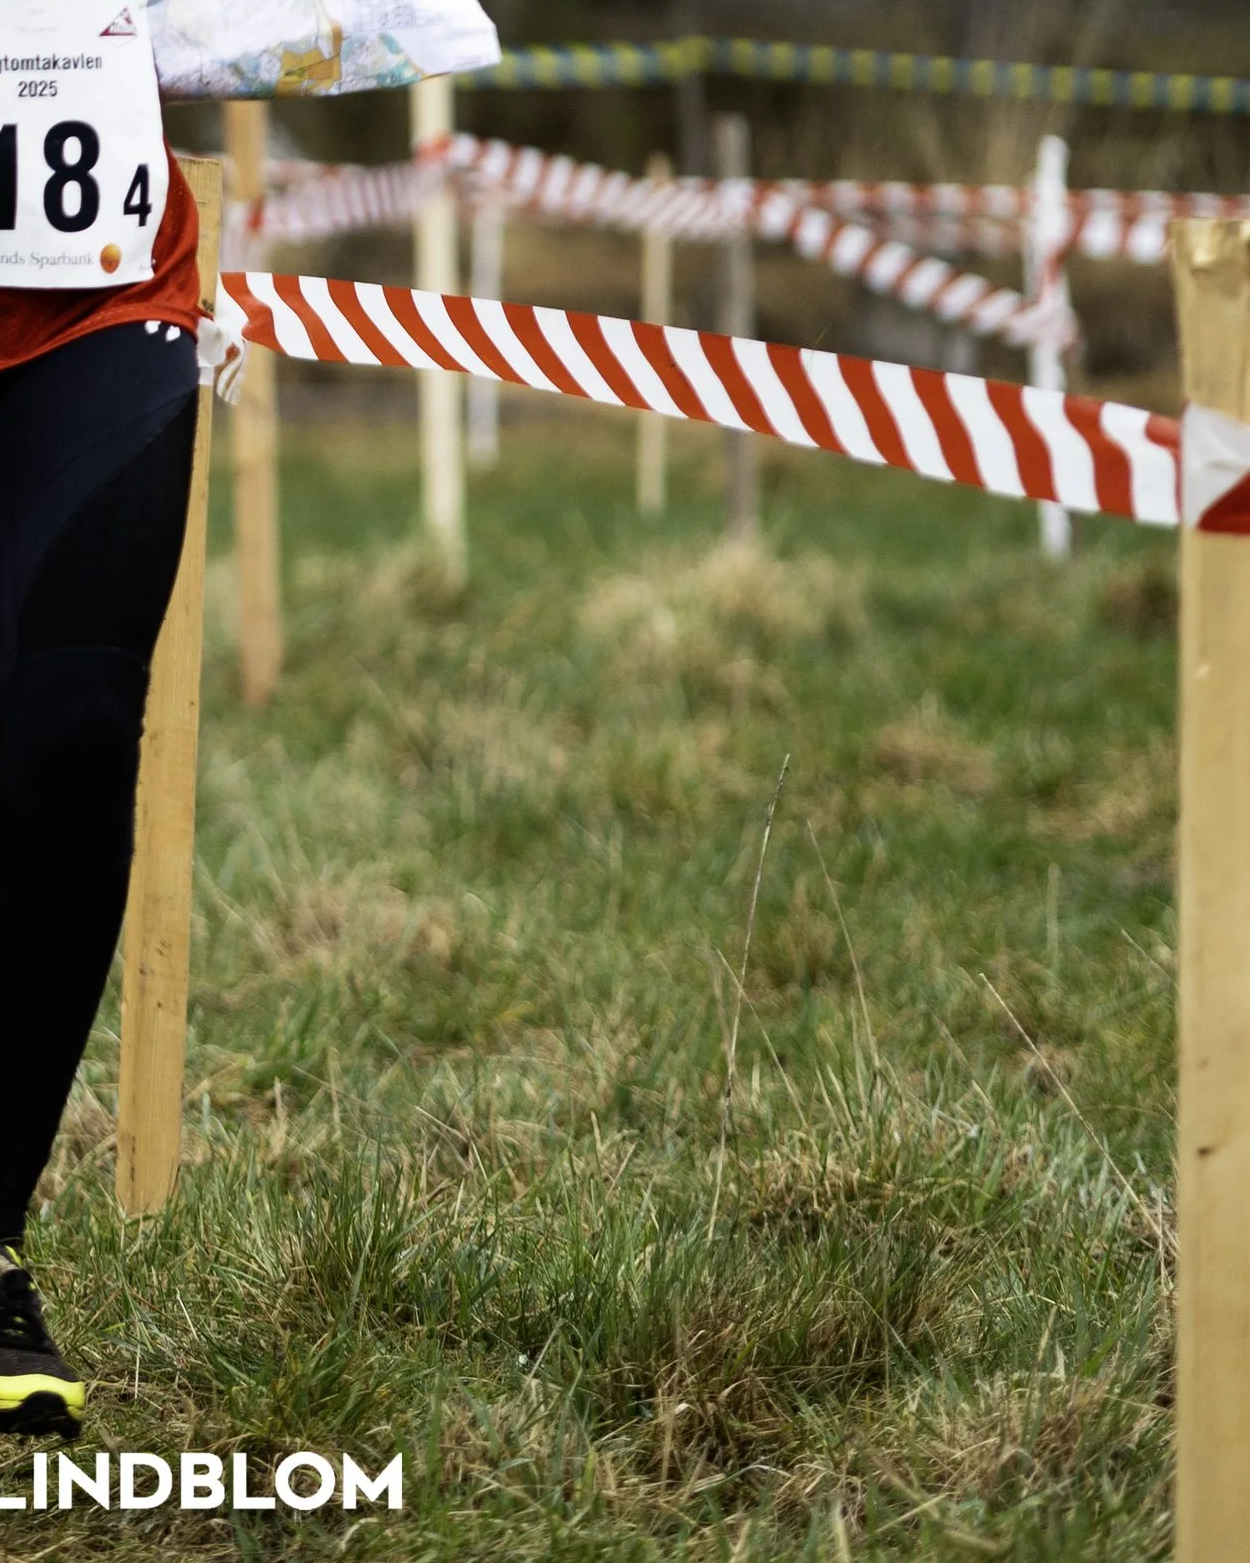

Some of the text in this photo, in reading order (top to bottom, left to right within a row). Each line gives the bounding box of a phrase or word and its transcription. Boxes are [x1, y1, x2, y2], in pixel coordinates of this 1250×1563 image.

[18, 80, 58, 98] 2025
[123, 163, 152, 227] 4
[30, 251, 94, 269] Sparbank
